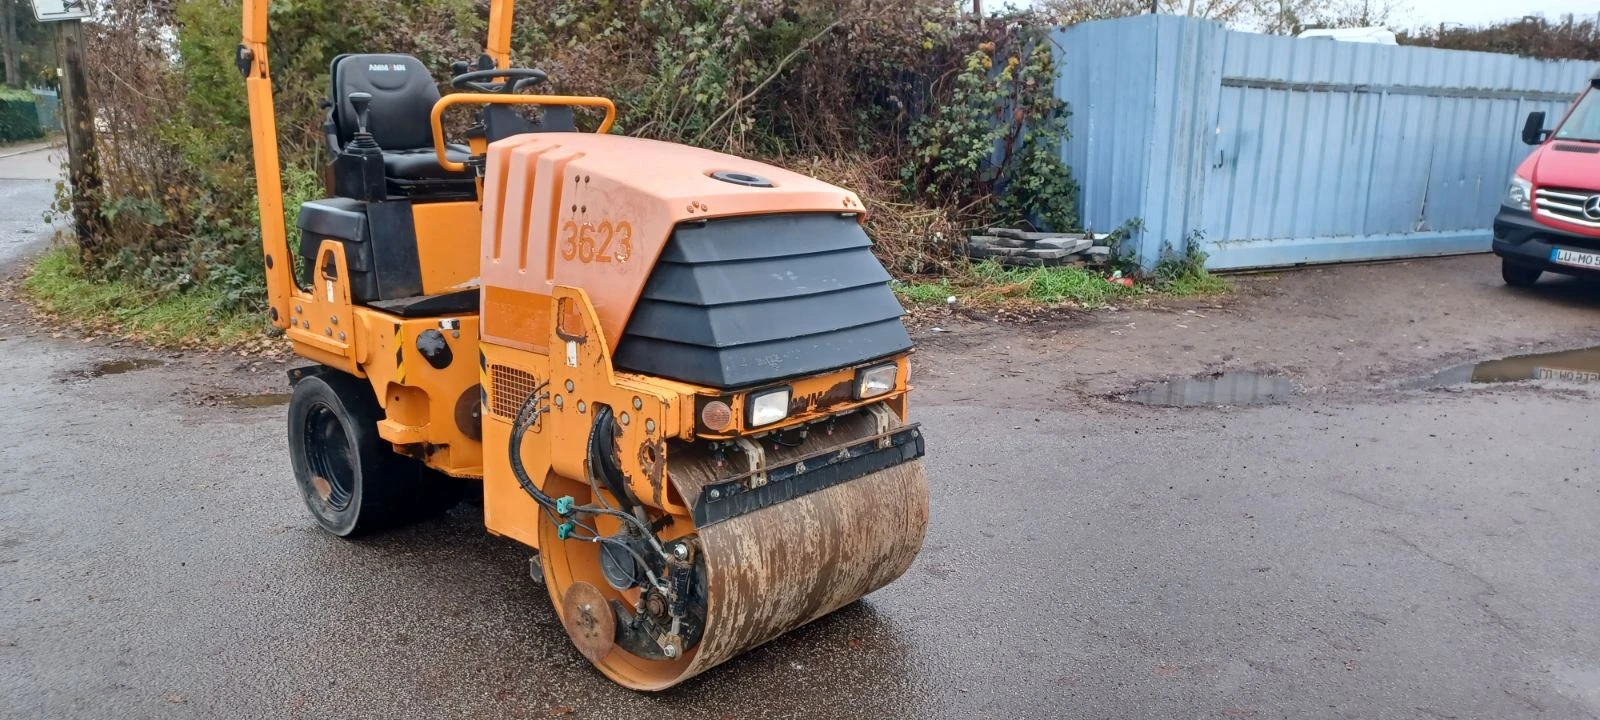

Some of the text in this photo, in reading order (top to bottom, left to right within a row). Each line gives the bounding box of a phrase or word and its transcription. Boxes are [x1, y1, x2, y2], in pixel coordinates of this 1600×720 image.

[562, 220, 633, 263] 3623
[1557, 250, 1571, 261] LU
[1578, 254, 1593, 265] MO
